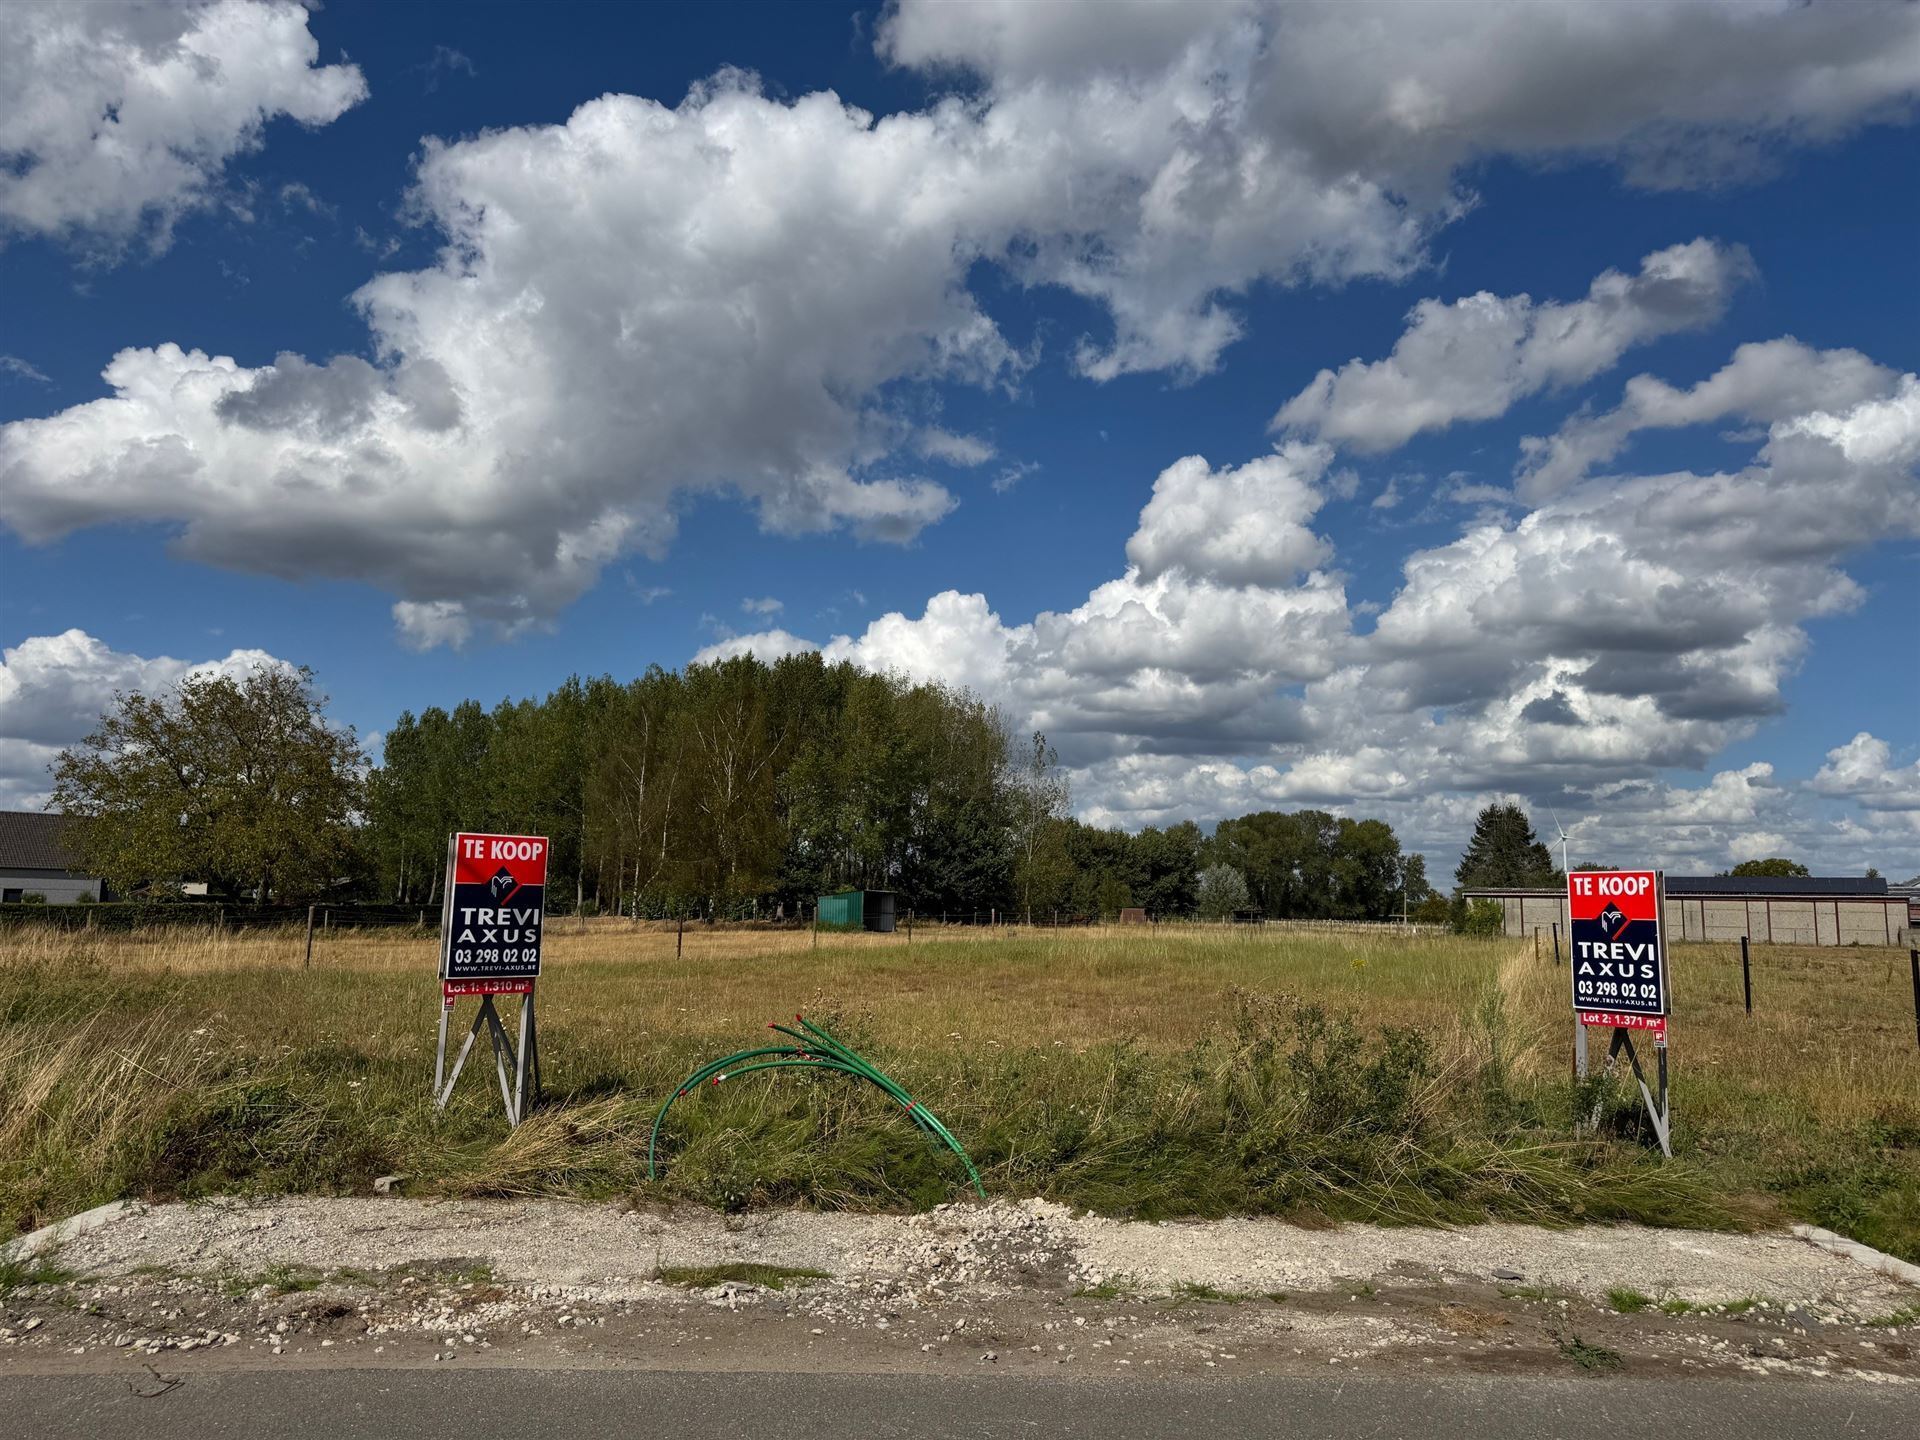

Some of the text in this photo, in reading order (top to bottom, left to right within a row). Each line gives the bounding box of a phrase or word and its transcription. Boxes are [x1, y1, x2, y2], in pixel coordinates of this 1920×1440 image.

[464, 839, 543, 861] TE KOOP
[1573, 876, 1650, 896] TE KOOP
[460, 907, 539, 926] TREVI
[457, 929, 537, 943] AXUS
[455, 948, 537, 964] 03 298 02 02
[1577, 941, 1655, 961] TREVI
[1578, 961, 1654, 979] AXUS
[447, 983, 466, 993] Lot
[469, 982, 479, 992] 1:
[483, 981, 512, 992] 1.310
[1578, 980, 1657, 999] 03 298 02 02
[1578, 995, 1657, 1007] WWW.TREVI-AXUS.BE
[1583, 1012, 1599, 1023] Lot
[1602, 1014, 1612, 1024] 2:
[1614, 1015, 1643, 1026] 1.371
